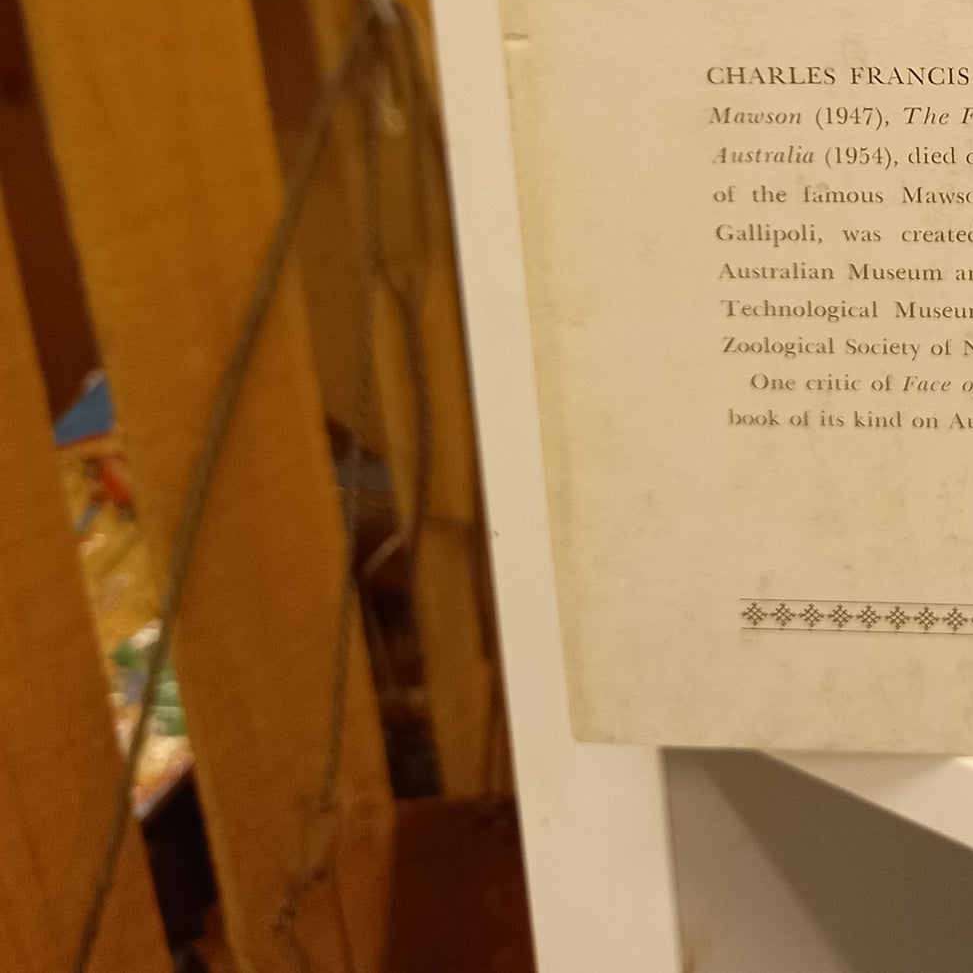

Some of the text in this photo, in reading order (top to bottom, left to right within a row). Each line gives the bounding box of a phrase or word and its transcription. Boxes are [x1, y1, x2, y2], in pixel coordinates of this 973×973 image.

[706, 66, 836, 85] CHARLES
[850, 66, 970, 85] FRANCIS
[708, 106, 802, 124] Mawson
[815, 106, 890, 131] (1947),
[903, 106, 950, 125] The
[711, 144, 815, 163] Australia
[824, 146, 899, 171] (1954),
[907, 146, 957, 164] died
[712, 185, 736, 202] of
[751, 184, 788, 203] the
[803, 183, 884, 203] famous
[715, 223, 823, 247] Gallipoli,
[841, 229, 882, 242] was
[718, 261, 835, 280] Australian
[847, 262, 944, 281] Museum
[720, 299, 879, 323] Technological
[722, 336, 835, 359] Zoological
[845, 337, 921, 361] Society
[930, 338, 952, 355] of
[749, 373, 797, 391] One
[805, 373, 862, 392] critic
[870, 374, 893, 391] of
[902, 375, 952, 392] Face
[728, 408, 781, 426] book
[789, 410, 810, 427] of
[820, 409, 845, 427] its
[853, 410, 903, 428] kind
[911, 416, 940, 429] on
